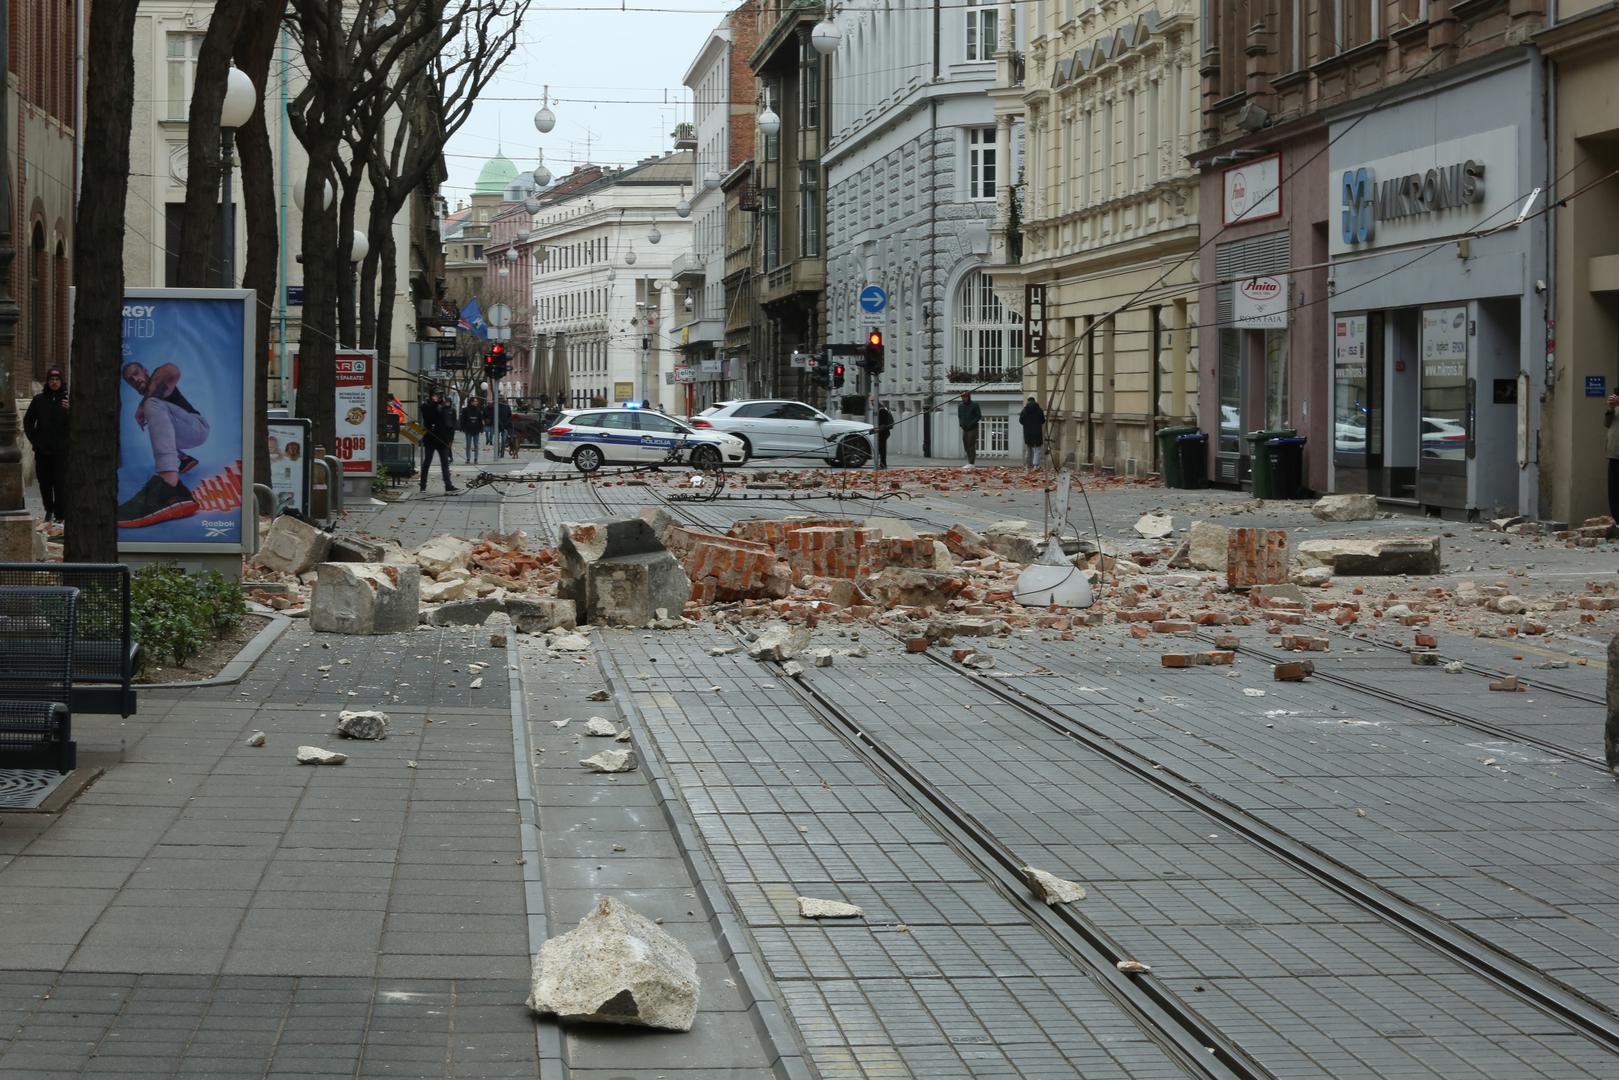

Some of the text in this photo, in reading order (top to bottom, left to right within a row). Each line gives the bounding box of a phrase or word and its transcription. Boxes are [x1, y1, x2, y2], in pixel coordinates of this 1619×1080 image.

[1373, 159, 1485, 221] MIKRONIS
[1244, 281, 1277, 291] Anita
[122, 305, 155, 317] RGY
[123, 318, 155, 338] IFIED
[1029, 287, 1043, 353] HOME
[201, 519, 235, 528] Reebok
